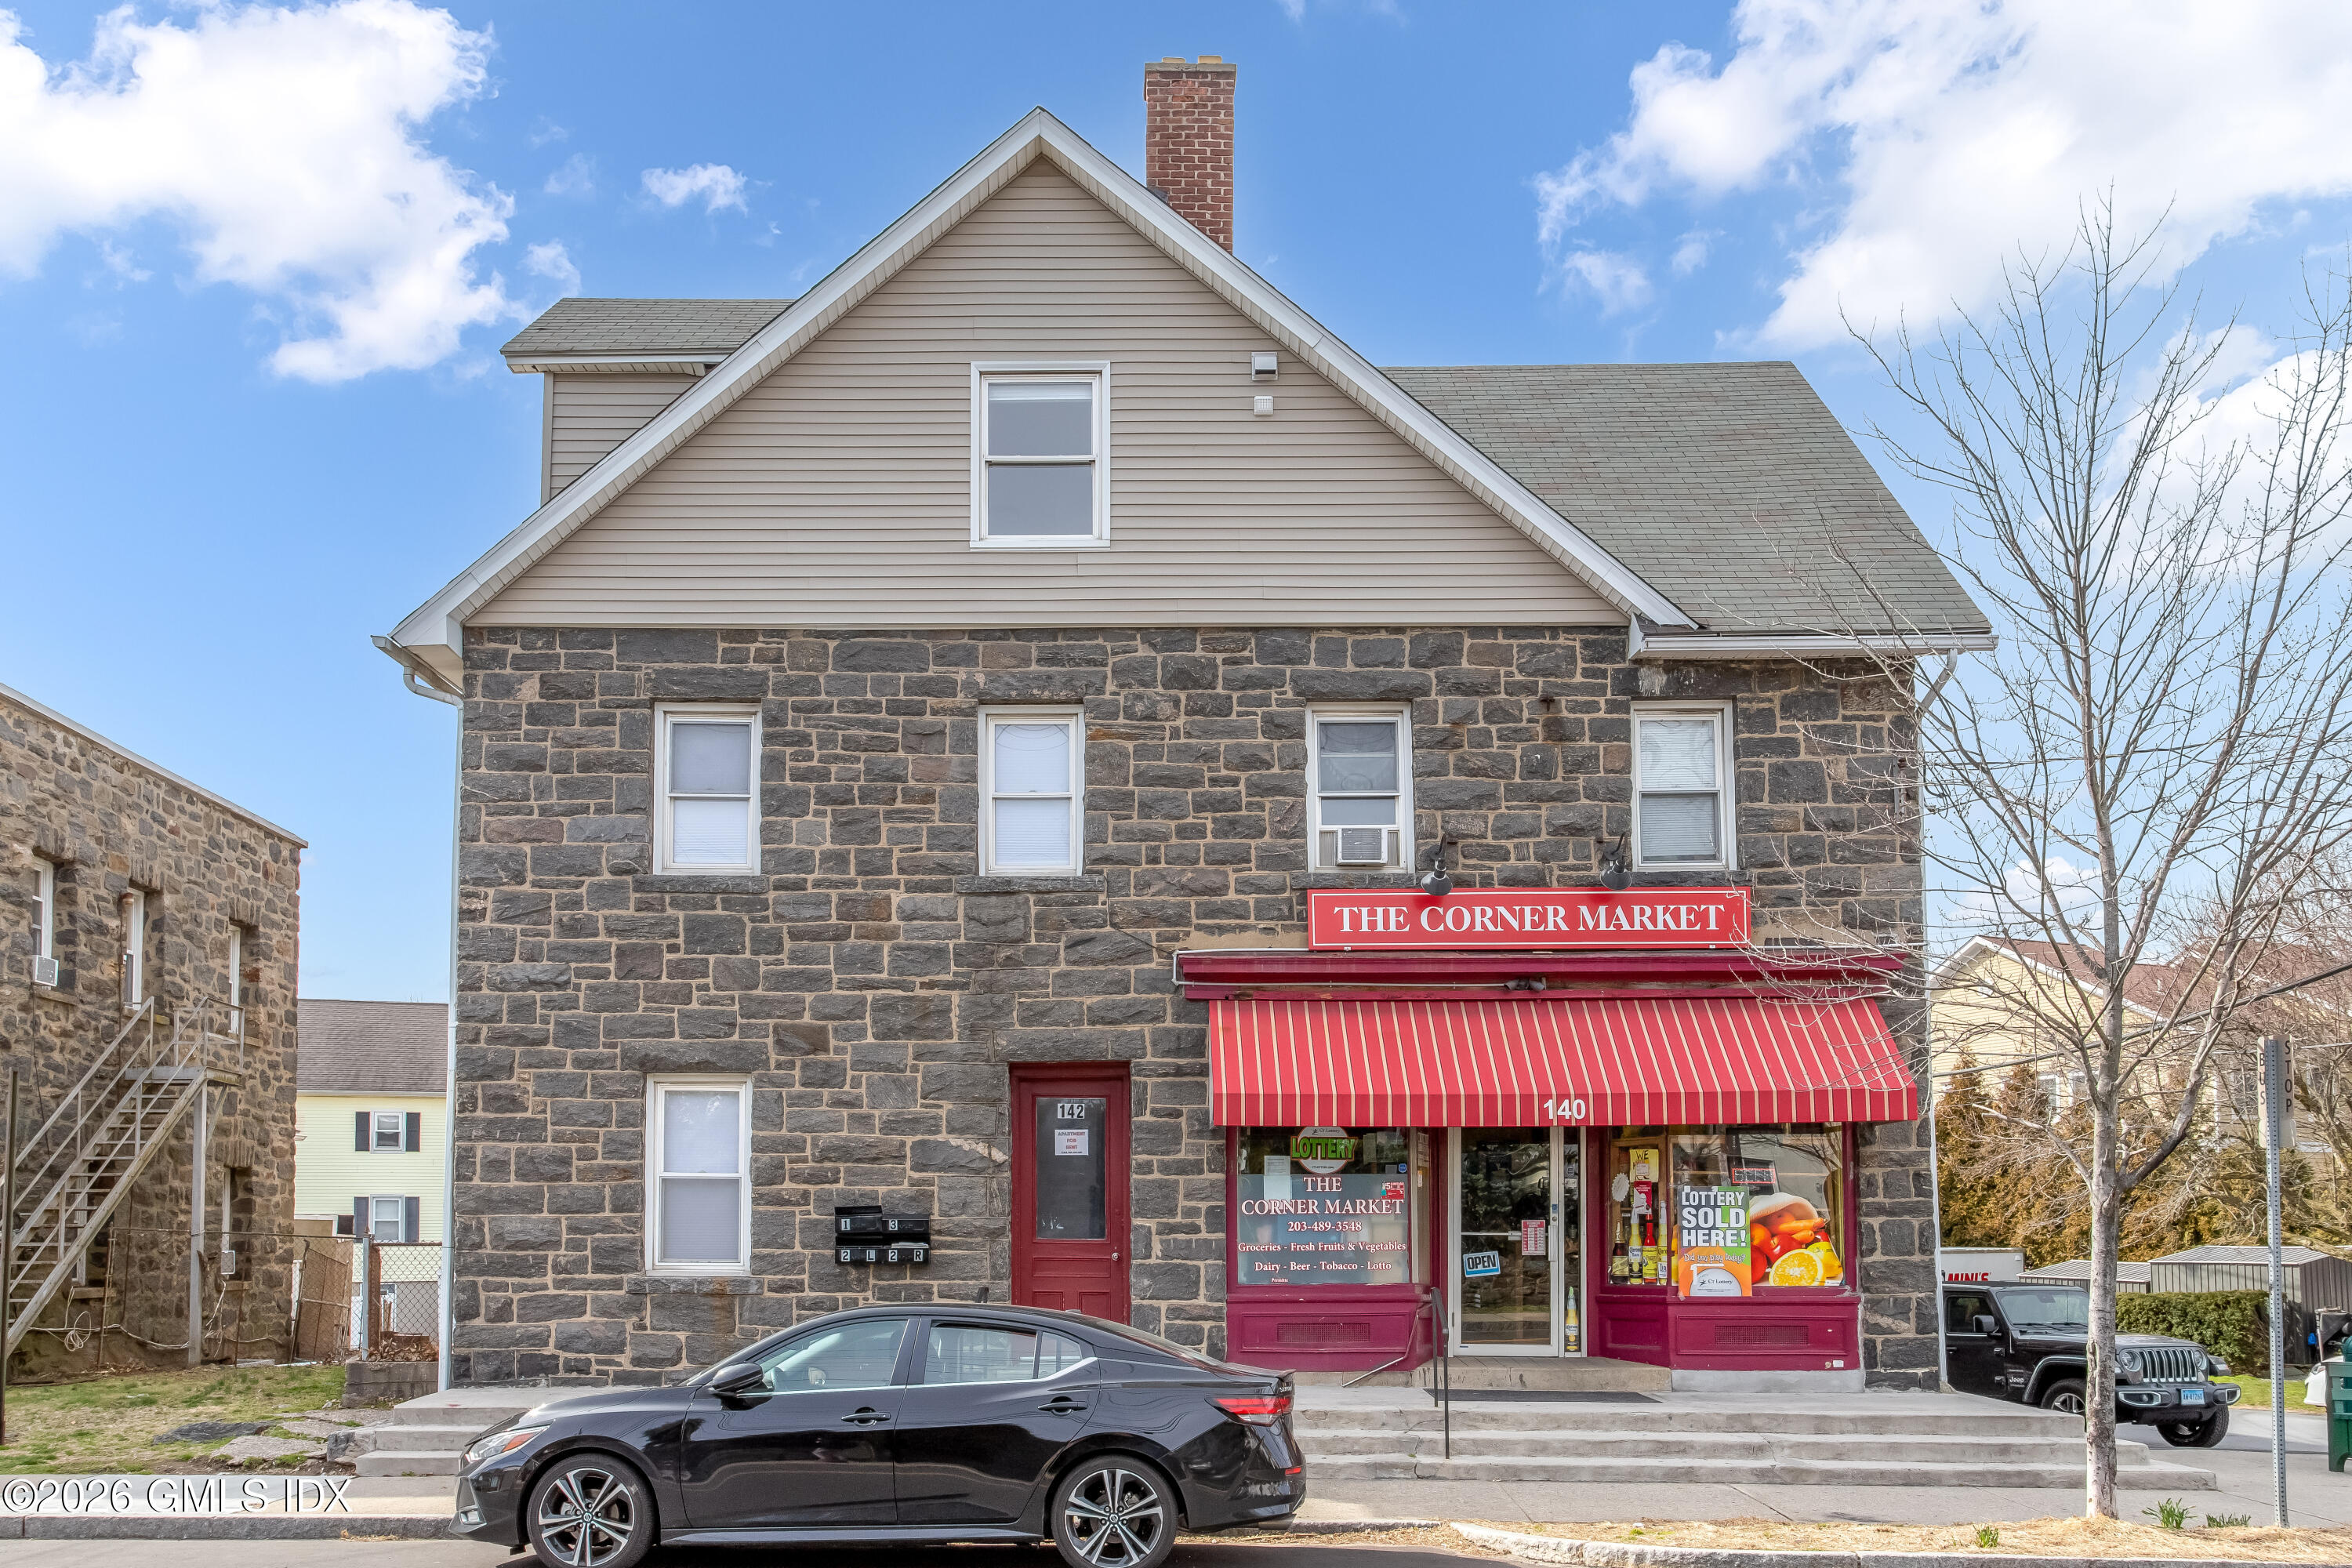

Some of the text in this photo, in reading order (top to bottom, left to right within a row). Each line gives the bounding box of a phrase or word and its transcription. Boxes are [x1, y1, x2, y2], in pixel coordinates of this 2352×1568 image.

[1334, 904, 1725, 932] THE CORNER MARKET
[1059, 1104, 1083, 1118] 142
[1543, 1099, 1586, 1120] 140
[1291, 1138, 1356, 1159] LOTTERY
[1635, 1149, 1649, 1160] WE
[1303, 1177, 1342, 1192] THE
[1682, 1191, 1745, 1206] LOTTERY
[1241, 1199, 1404, 1215] CORNER MARKET
[844, 1220, 848, 1229] 1
[891, 1220, 896, 1229] 3
[1682, 1207, 1746, 1228] SOLD
[1287, 1221, 1362, 1232] 203-489-3548
[1682, 1229, 1747, 1247] HERE!
[1238, 1242, 1281, 1251] Groceries
[1290, 1242, 1316, 1251] Fresh
[1318, 1241, 1345, 1251] Fruits
[1348, 1242, 1356, 1250] &
[1358, 1241, 1406, 1253] Vegetables
[843, 1251, 873, 1260] 2 L
[891, 1250, 921, 1260] 2 R
[1467, 1254, 1497, 1270] OPEN
[1684, 1253, 1695, 1261] Did
[1709, 1253, 1723, 1263] play
[1725, 1253, 1746, 1264] today?
[1254, 1261, 1280, 1272] Dairy
[1290, 1261, 1311, 1271] Beer
[1319, 1261, 1358, 1270] Tobacco
[1367, 1261, 1392, 1270] Lotto
